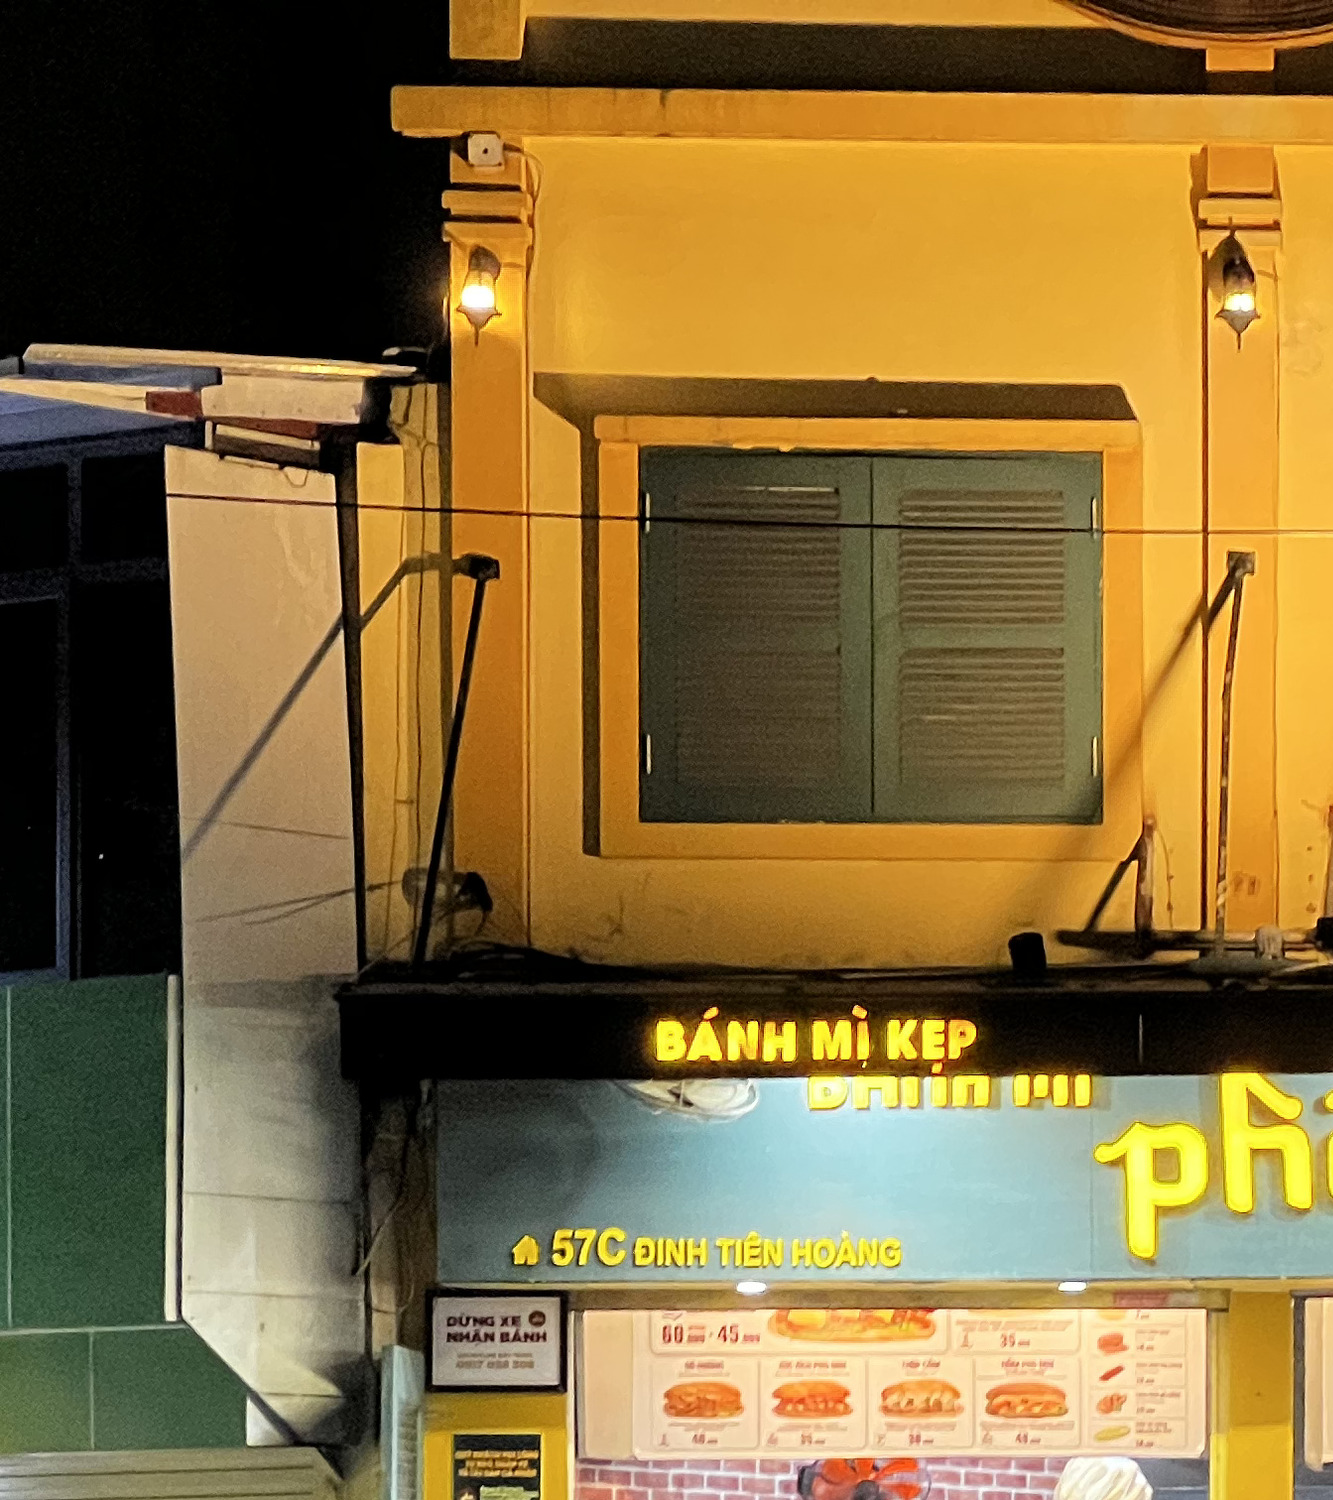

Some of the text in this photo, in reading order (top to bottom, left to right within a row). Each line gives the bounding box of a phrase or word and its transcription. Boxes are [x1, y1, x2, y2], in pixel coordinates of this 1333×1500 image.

[655, 1004, 977, 1074] BÁNH MÌ KẸP
[551, 1227, 902, 1268] 57C ĐINH TIÊN HOÀNG
[500, 1316, 521, 1327] XE
